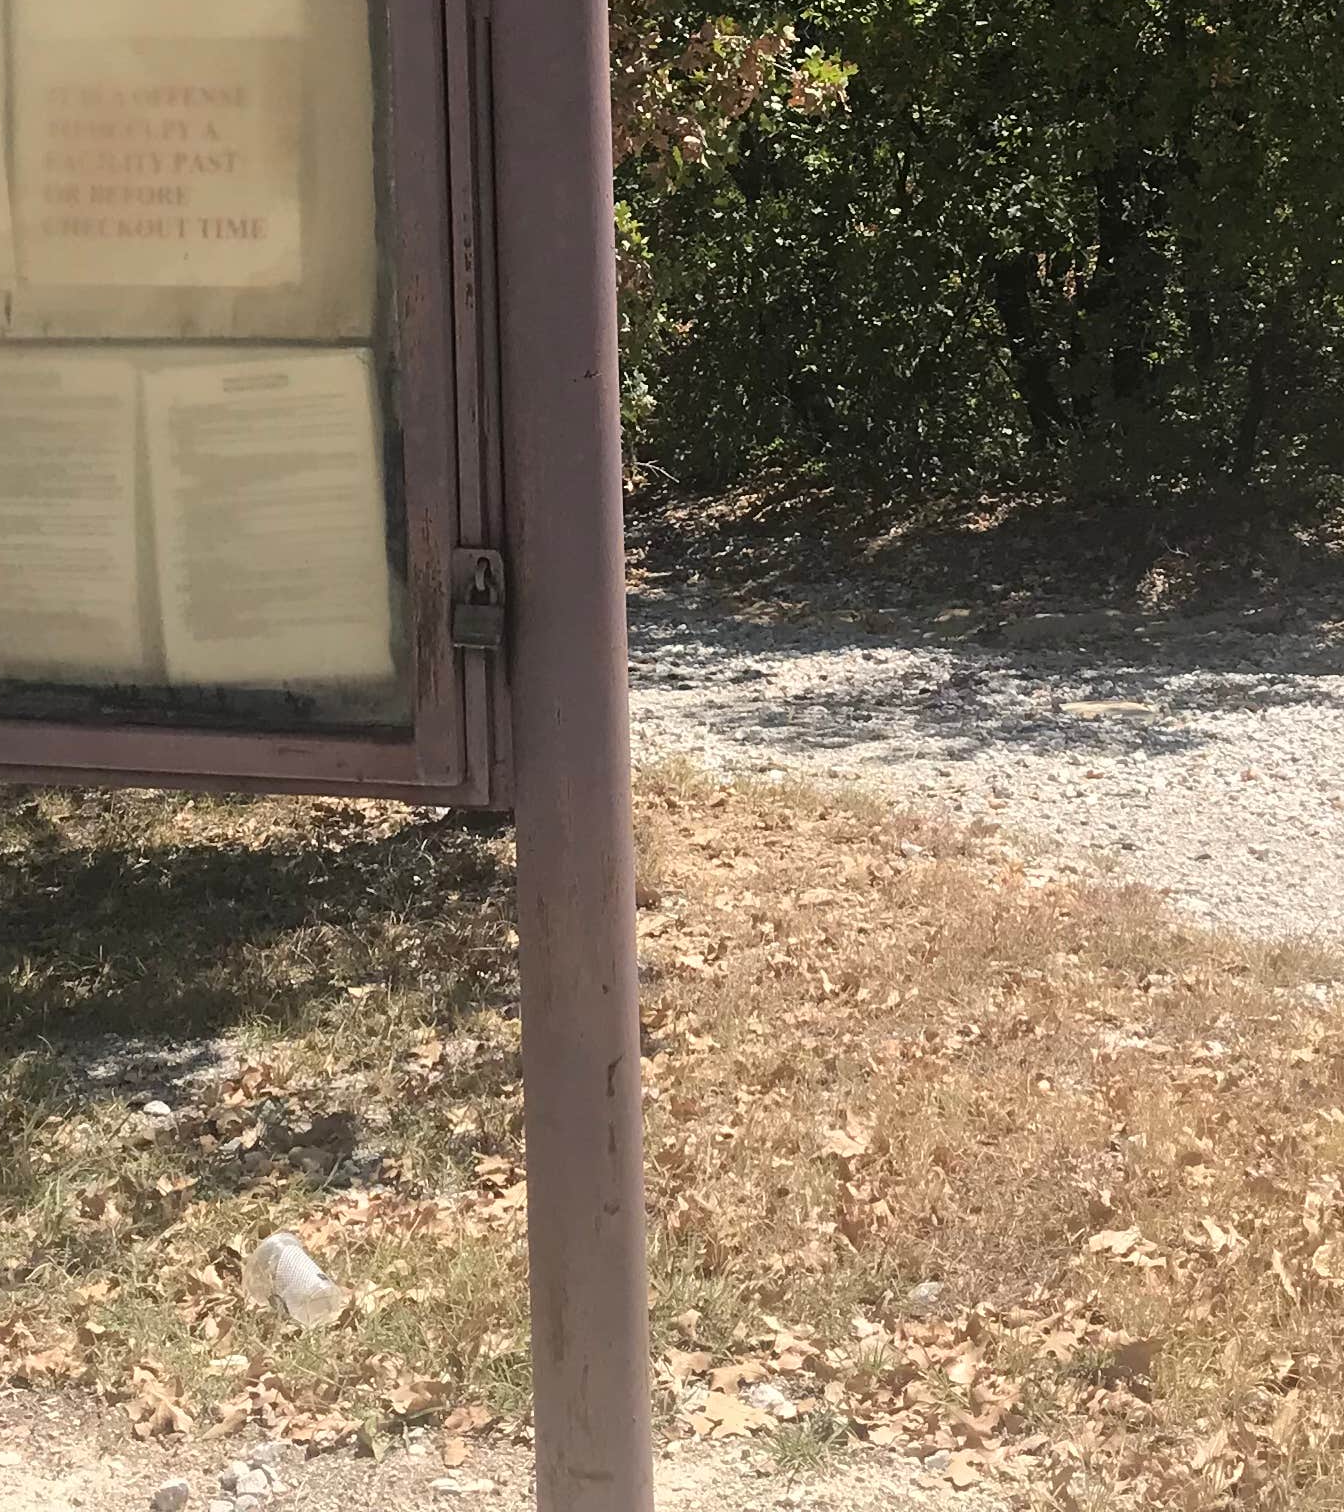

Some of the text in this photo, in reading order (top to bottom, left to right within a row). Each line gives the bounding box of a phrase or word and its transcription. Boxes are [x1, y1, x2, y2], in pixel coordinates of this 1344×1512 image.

[171, 152, 239, 174] PAST
[88, 184, 190, 205] BEFORE
[42, 215, 270, 239] CHECKOUT TIME
